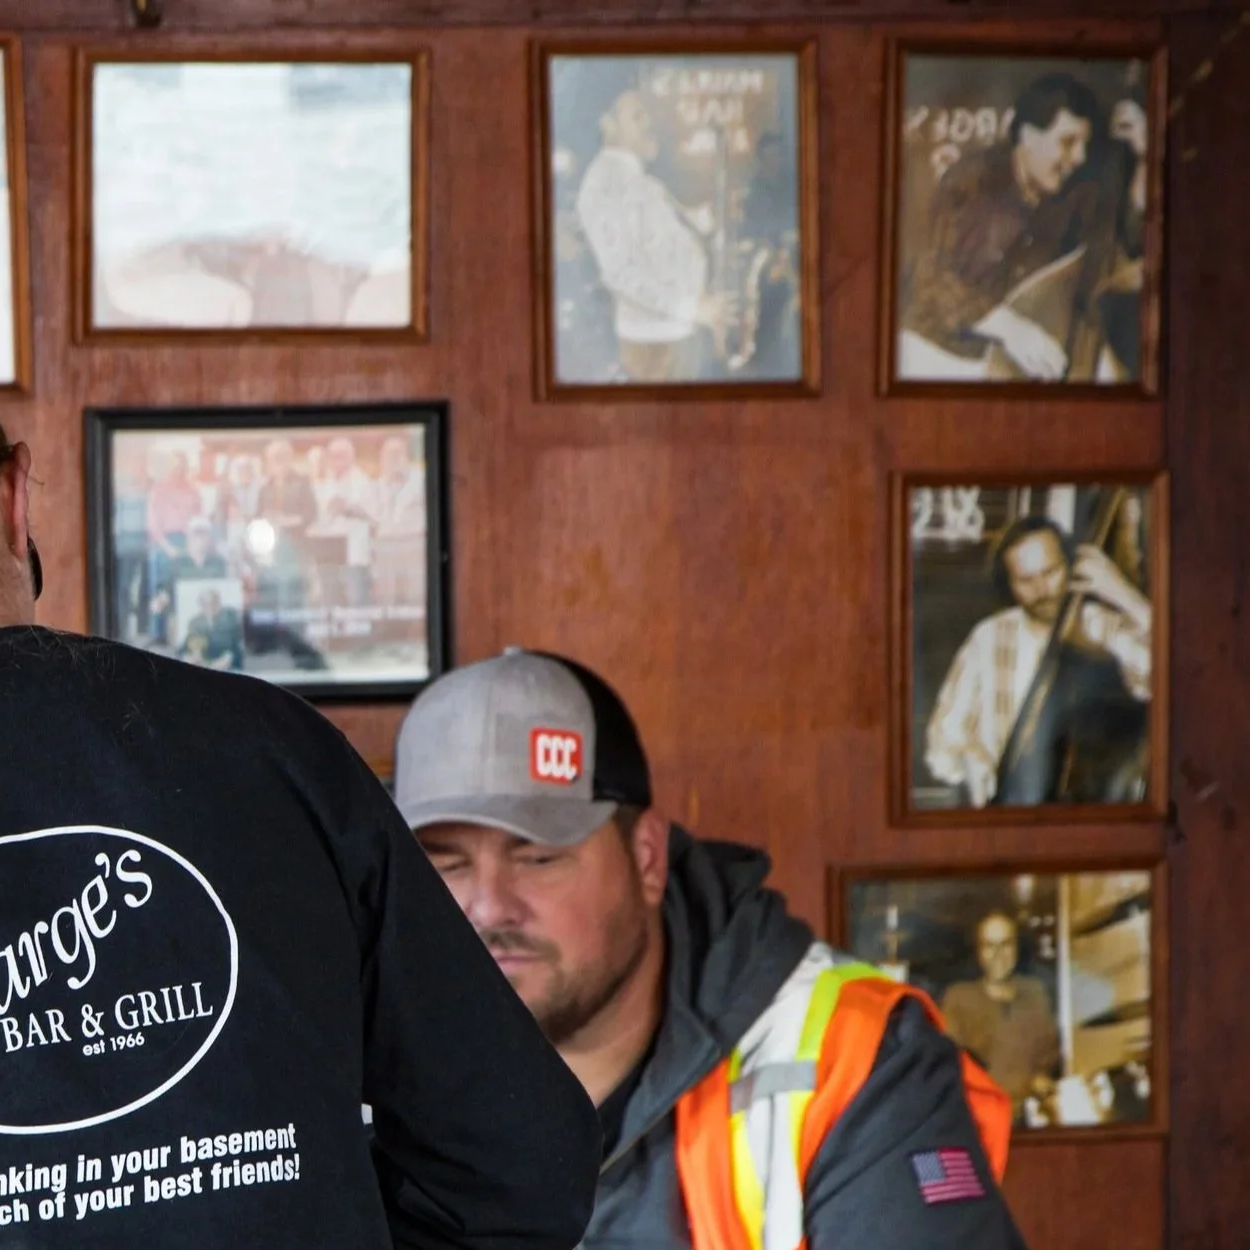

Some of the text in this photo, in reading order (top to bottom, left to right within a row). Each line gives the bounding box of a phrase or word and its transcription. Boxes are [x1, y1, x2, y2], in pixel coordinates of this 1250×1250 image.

[0, 981, 213, 1053] BAR & GRILL
[83, 1031, 145, 1056] est 1966
[77, 1154, 101, 1181] in
[111, 1144, 171, 1178] your
[180, 1123, 297, 1164] basement
[39, 1191, 66, 1220] of
[75, 1184, 134, 1220] your
[143, 1163, 202, 1203] best
[210, 1153, 301, 1191] friends!
